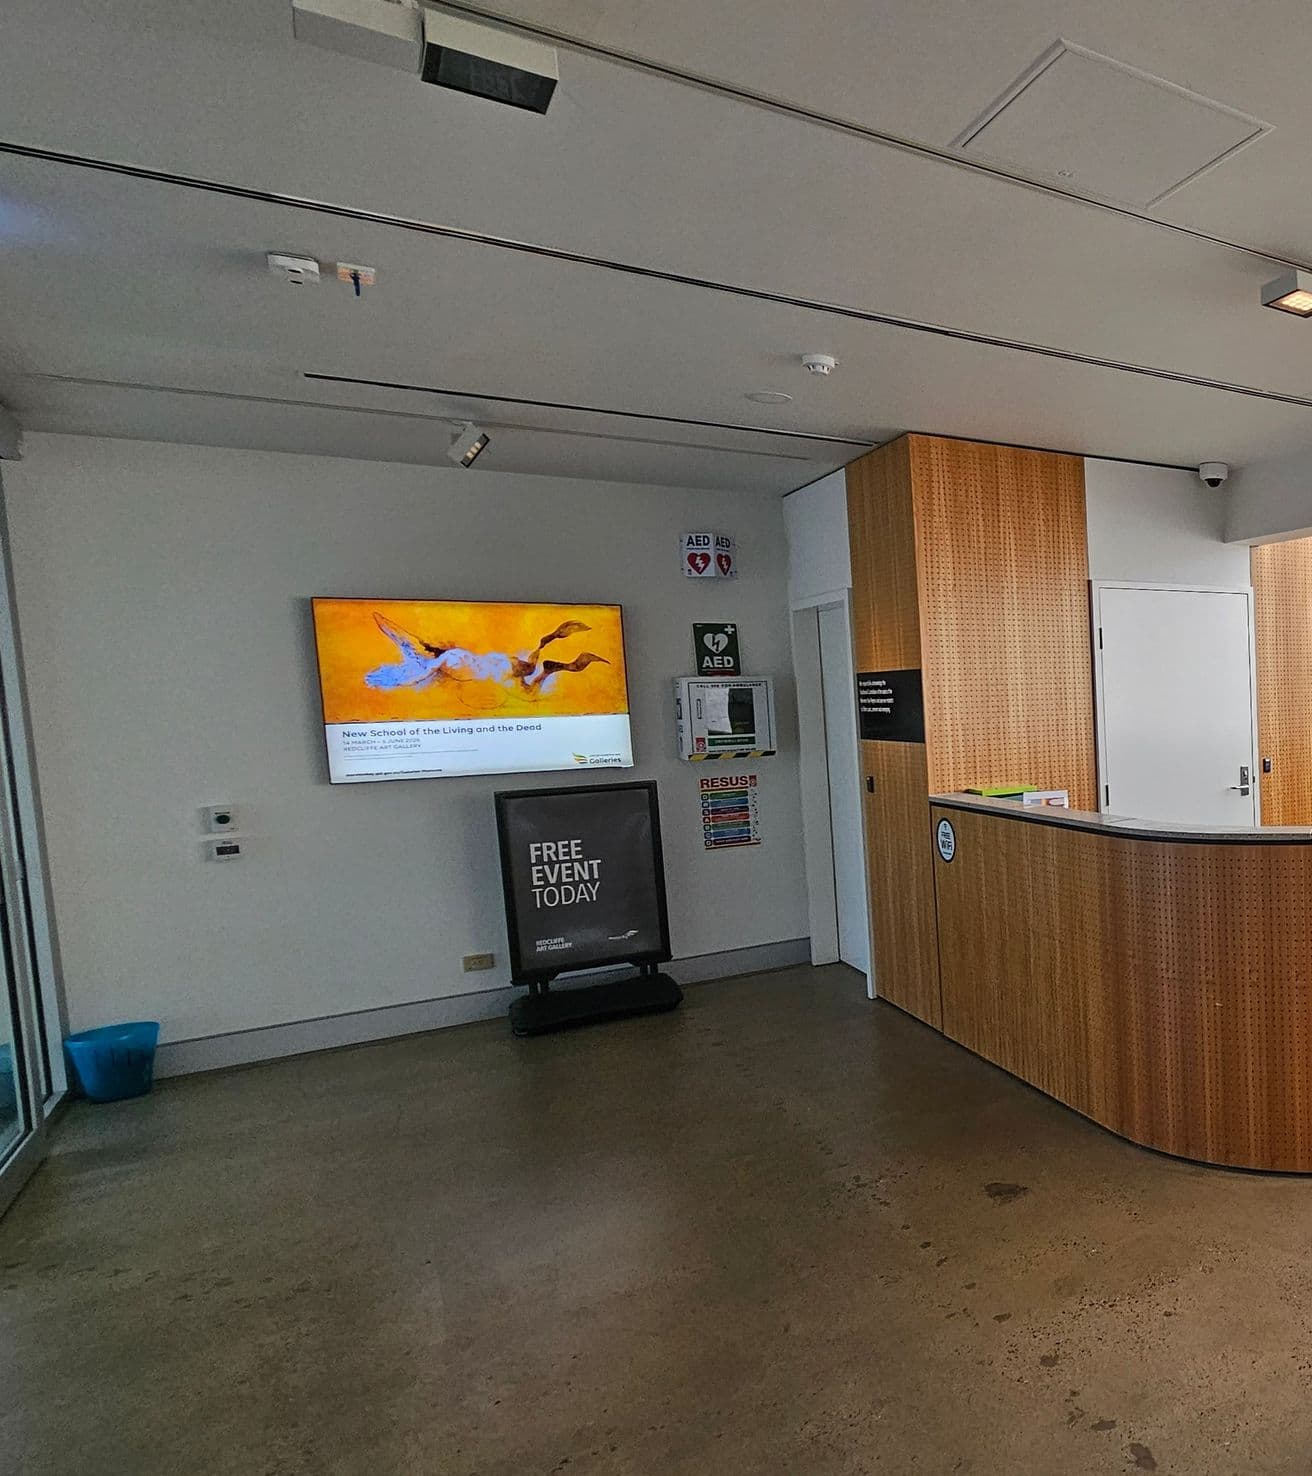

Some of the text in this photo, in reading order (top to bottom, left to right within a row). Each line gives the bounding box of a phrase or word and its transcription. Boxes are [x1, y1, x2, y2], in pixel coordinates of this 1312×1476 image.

[687, 535, 710, 546] AED
[716, 536, 730, 548] AED
[702, 656, 734, 668] AED
[342, 730, 368, 738] New
[370, 728, 406, 737] School
[409, 727, 420, 735] of
[423, 727, 440, 735] the
[443, 726, 473, 735] Living
[476, 724, 495, 733] and
[589, 756, 622, 765] Galleries
[700, 776, 749, 788] RESUS
[529, 839, 583, 863] FREE
[531, 860, 601, 886] EVENT
[531, 881, 600, 908] TODAY
[548, 942, 573, 950] GALLERY
